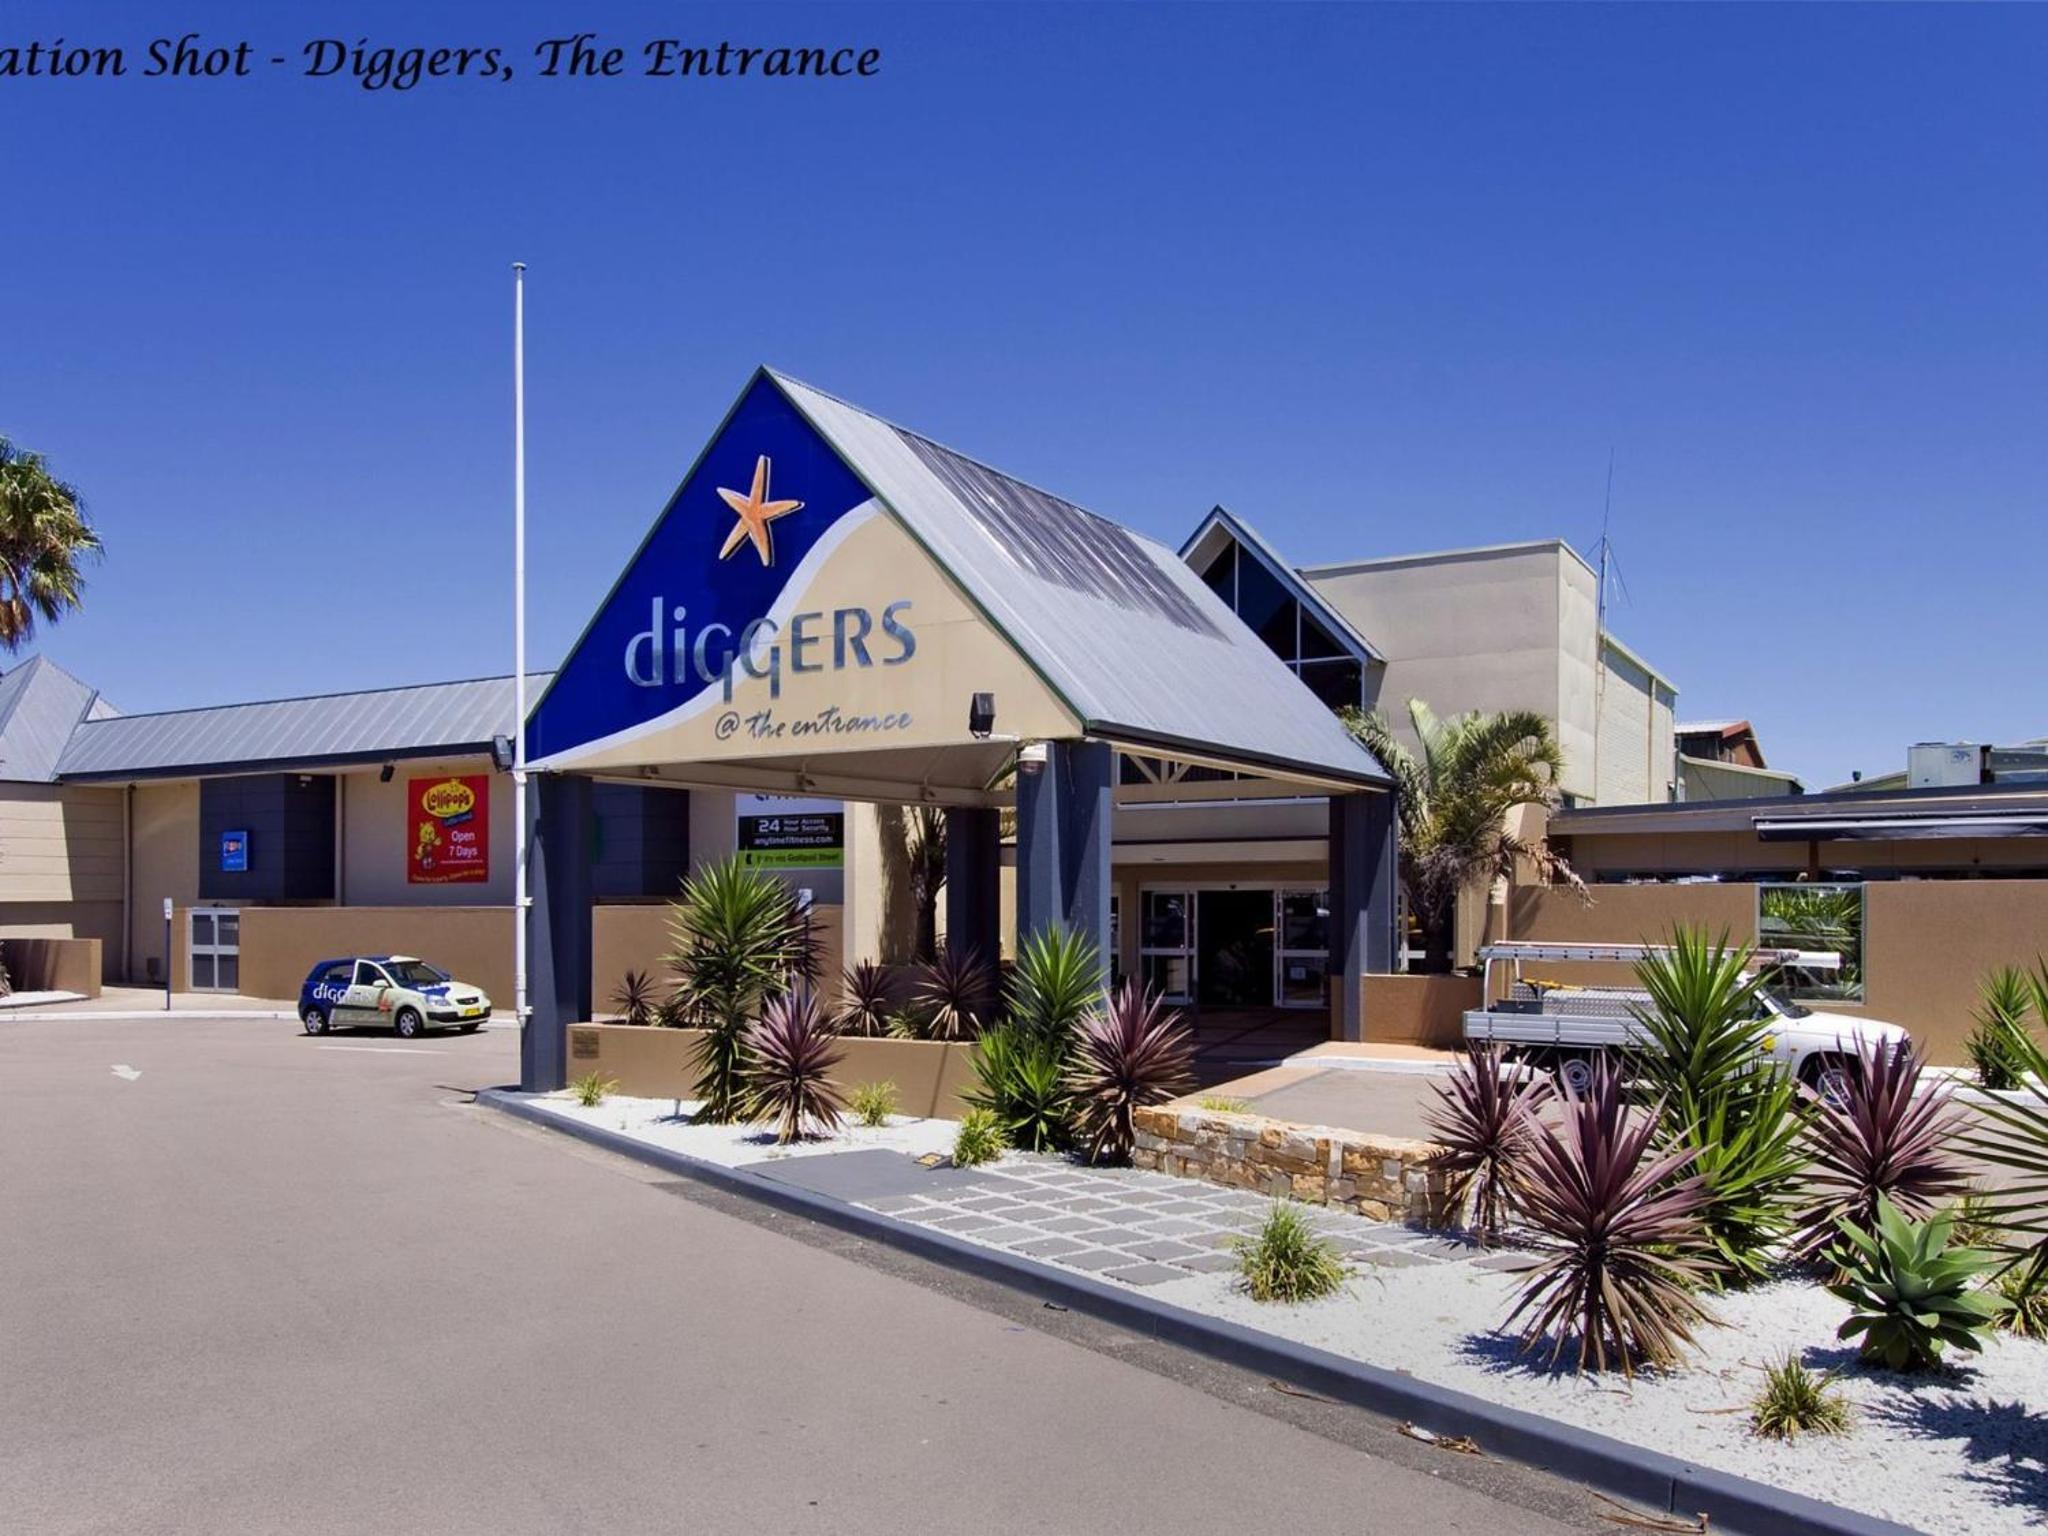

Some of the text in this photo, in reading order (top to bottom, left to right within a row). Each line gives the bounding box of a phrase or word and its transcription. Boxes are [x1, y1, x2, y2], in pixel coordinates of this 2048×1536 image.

[714, 705, 914, 741] @ the entrance
[758, 819, 780, 833] 24
[451, 830, 476, 843] Open
[448, 845, 478, 858] 7 Days
